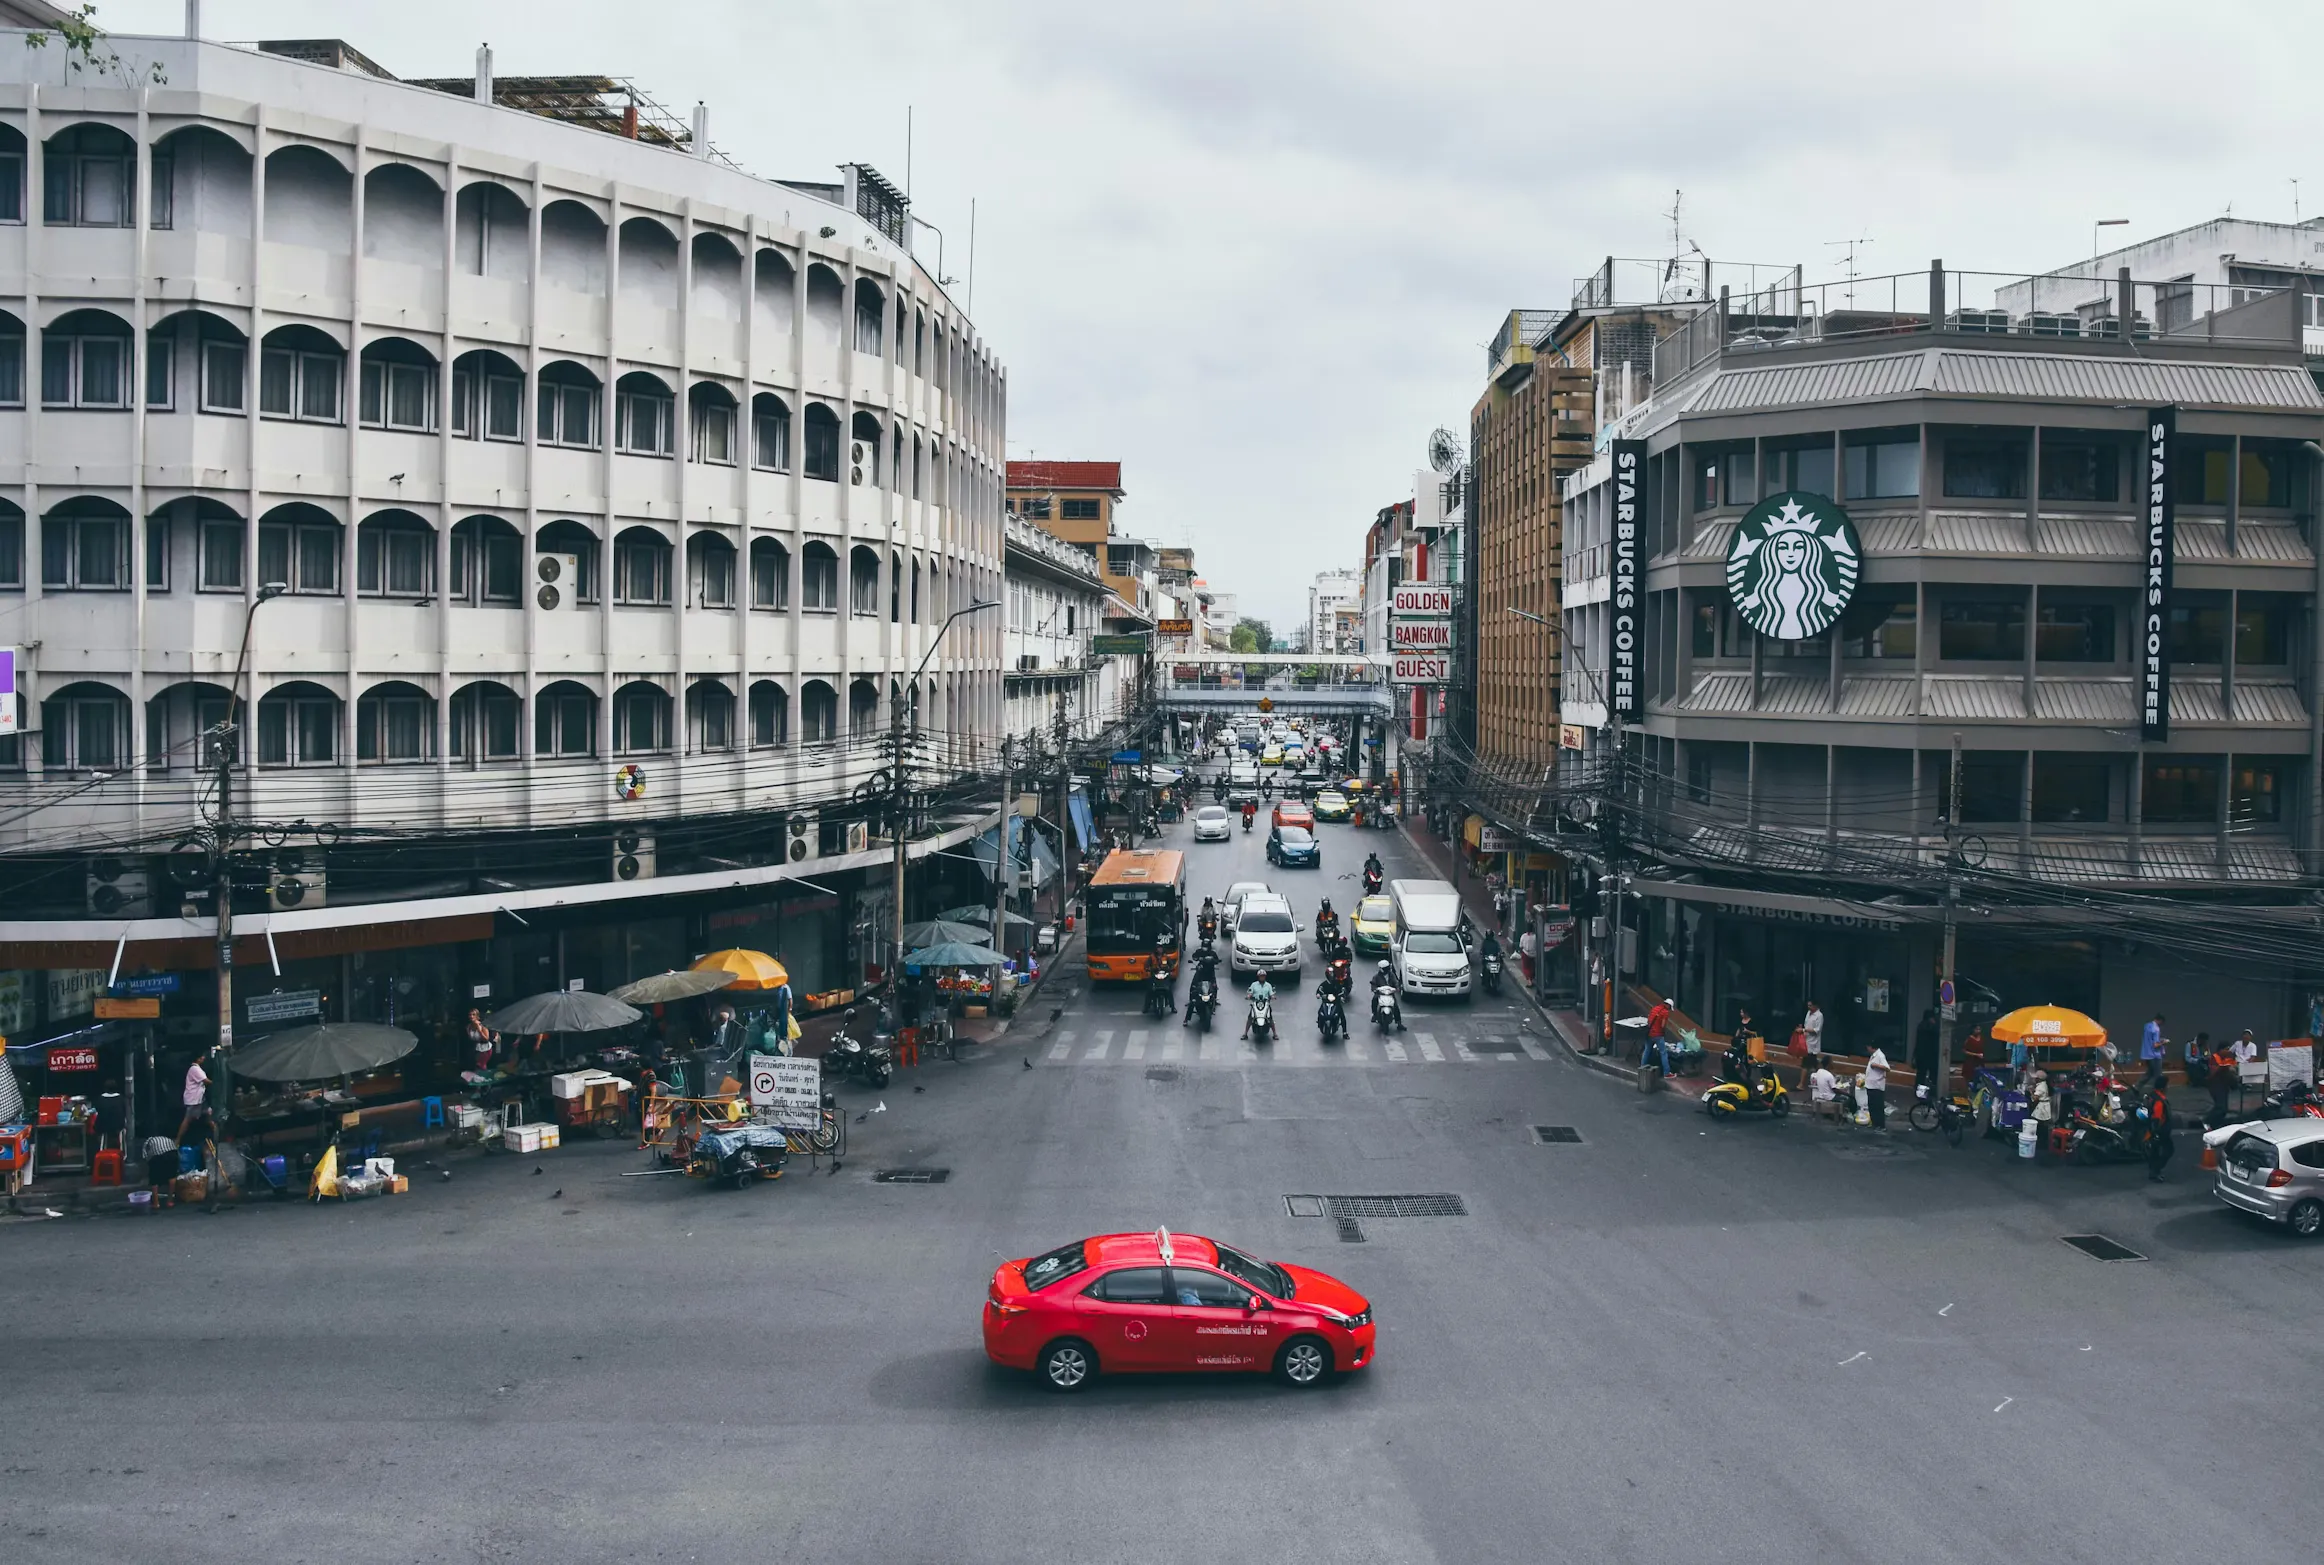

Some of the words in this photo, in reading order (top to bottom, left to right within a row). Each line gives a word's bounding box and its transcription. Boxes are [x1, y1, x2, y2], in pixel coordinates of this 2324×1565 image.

[2149, 423, 2164, 607] STARBUCKS
[1617, 452, 1636, 609] STARBUCKS
[1396, 593, 1449, 610] GOLDEN
[1396, 626, 1449, 644] BANGKOK
[1396, 660, 1447, 678] GUEST
[1615, 615, 1634, 710] COFFEE
[2146, 614, 2161, 725] COFFEE
[1717, 902, 1824, 924] STARBUCKS
[1830, 914, 1900, 932] COFFEE
[51, 1052, 95, 1065] เกาลัด
